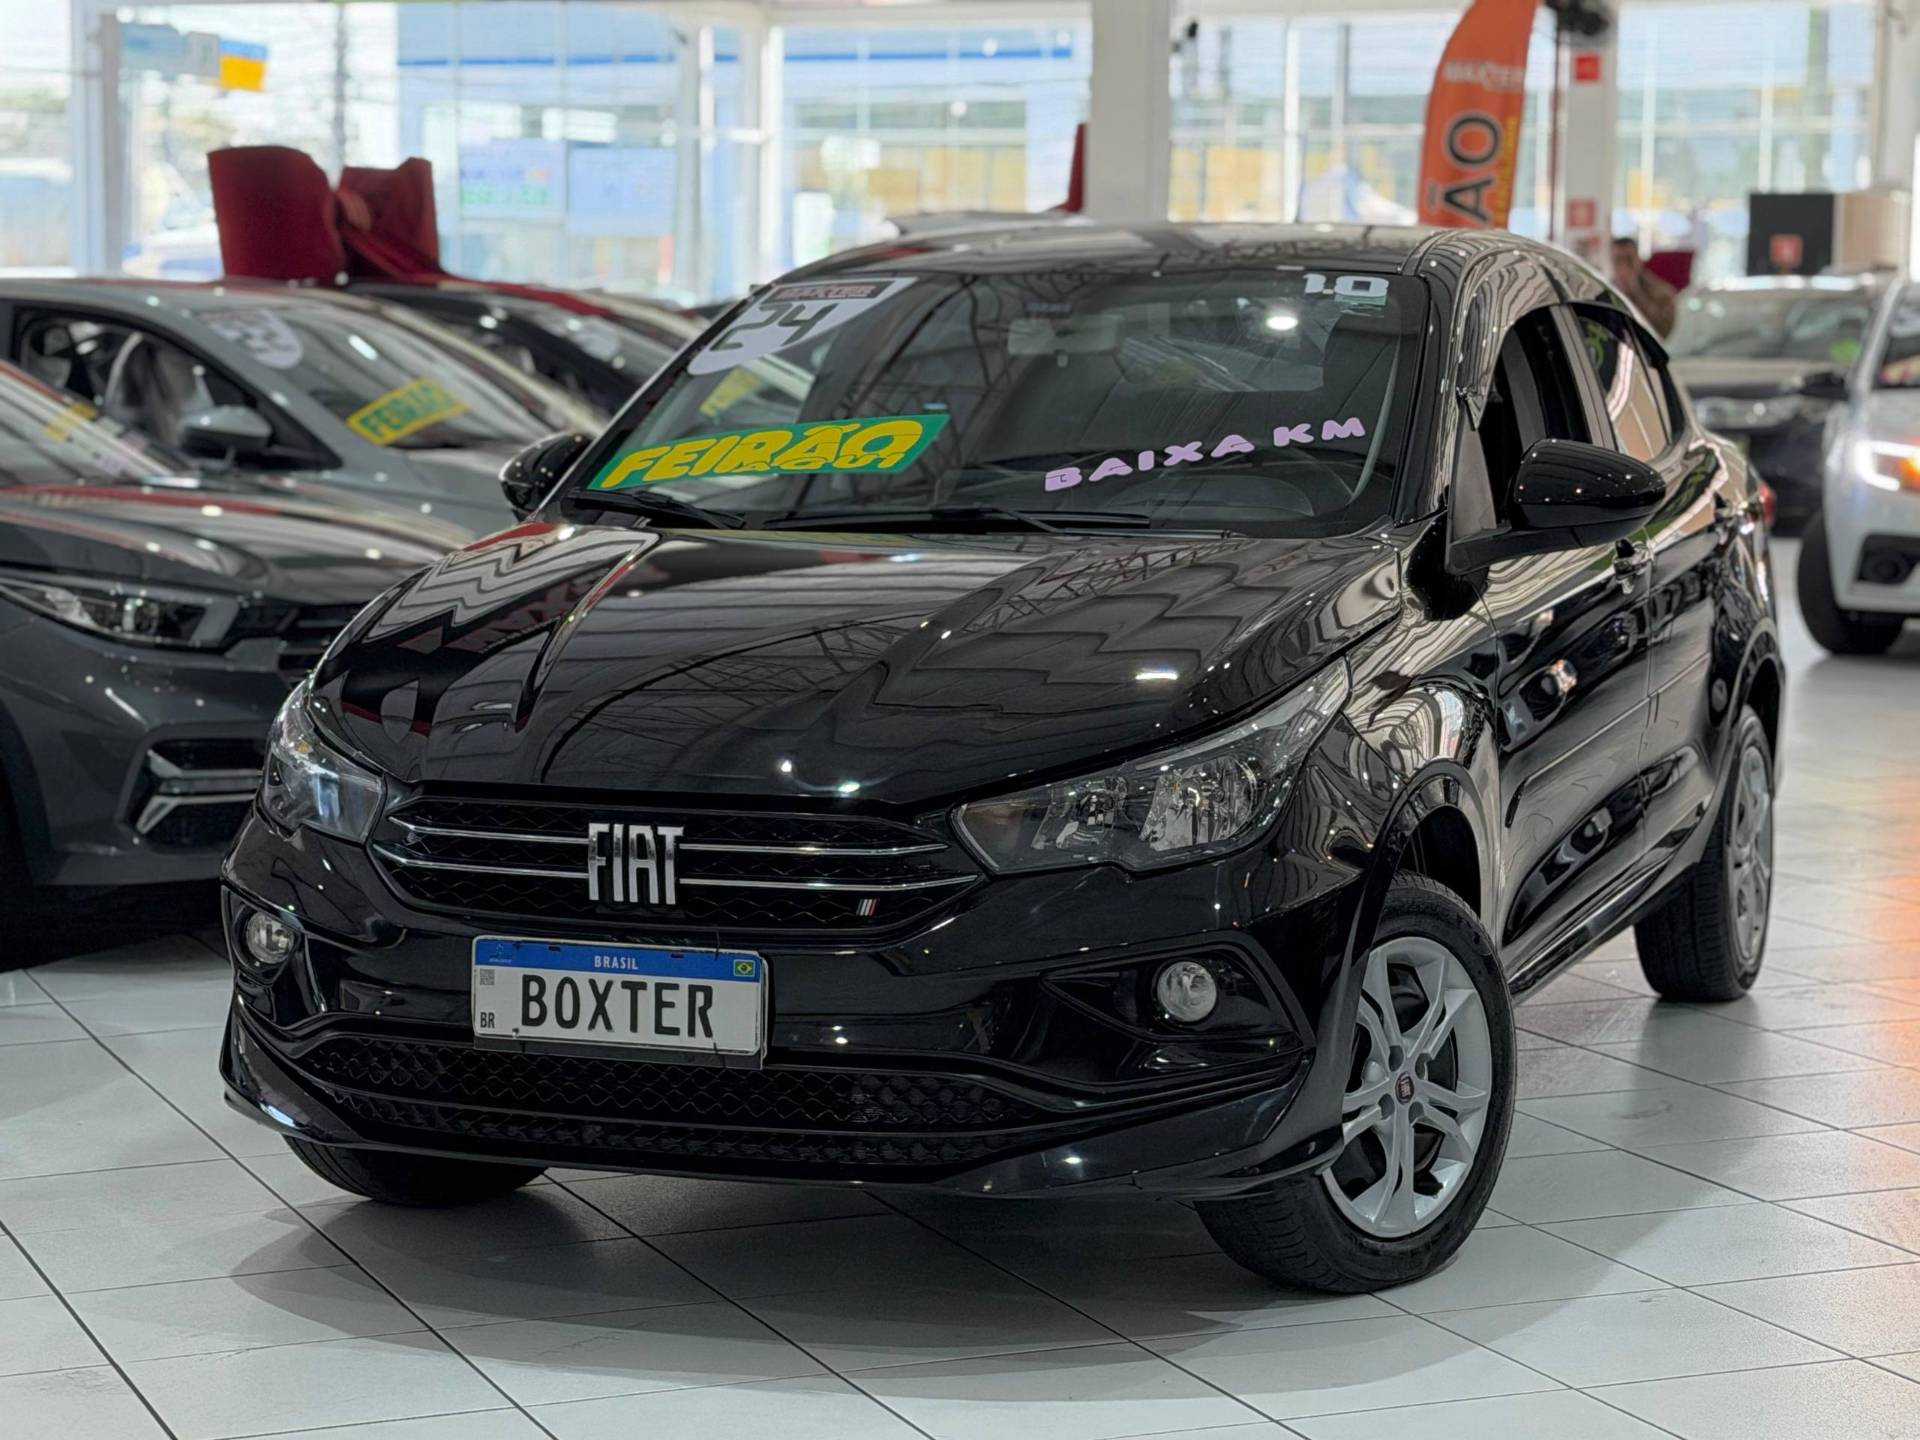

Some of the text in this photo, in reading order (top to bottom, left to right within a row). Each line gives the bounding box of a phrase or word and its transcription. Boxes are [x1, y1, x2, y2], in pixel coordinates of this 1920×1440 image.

[1302, 273, 1389, 297] 1.0
[709, 303, 838, 351] 24
[600, 420, 923, 489] FEIRÃO
[1045, 417, 1366, 492] BAIXA KM
[588, 822, 684, 905] FIAT
[594, 955, 639, 970] BRASIL
[480, 1011, 495, 1029] BR
[521, 974, 714, 1038] BOXTER
